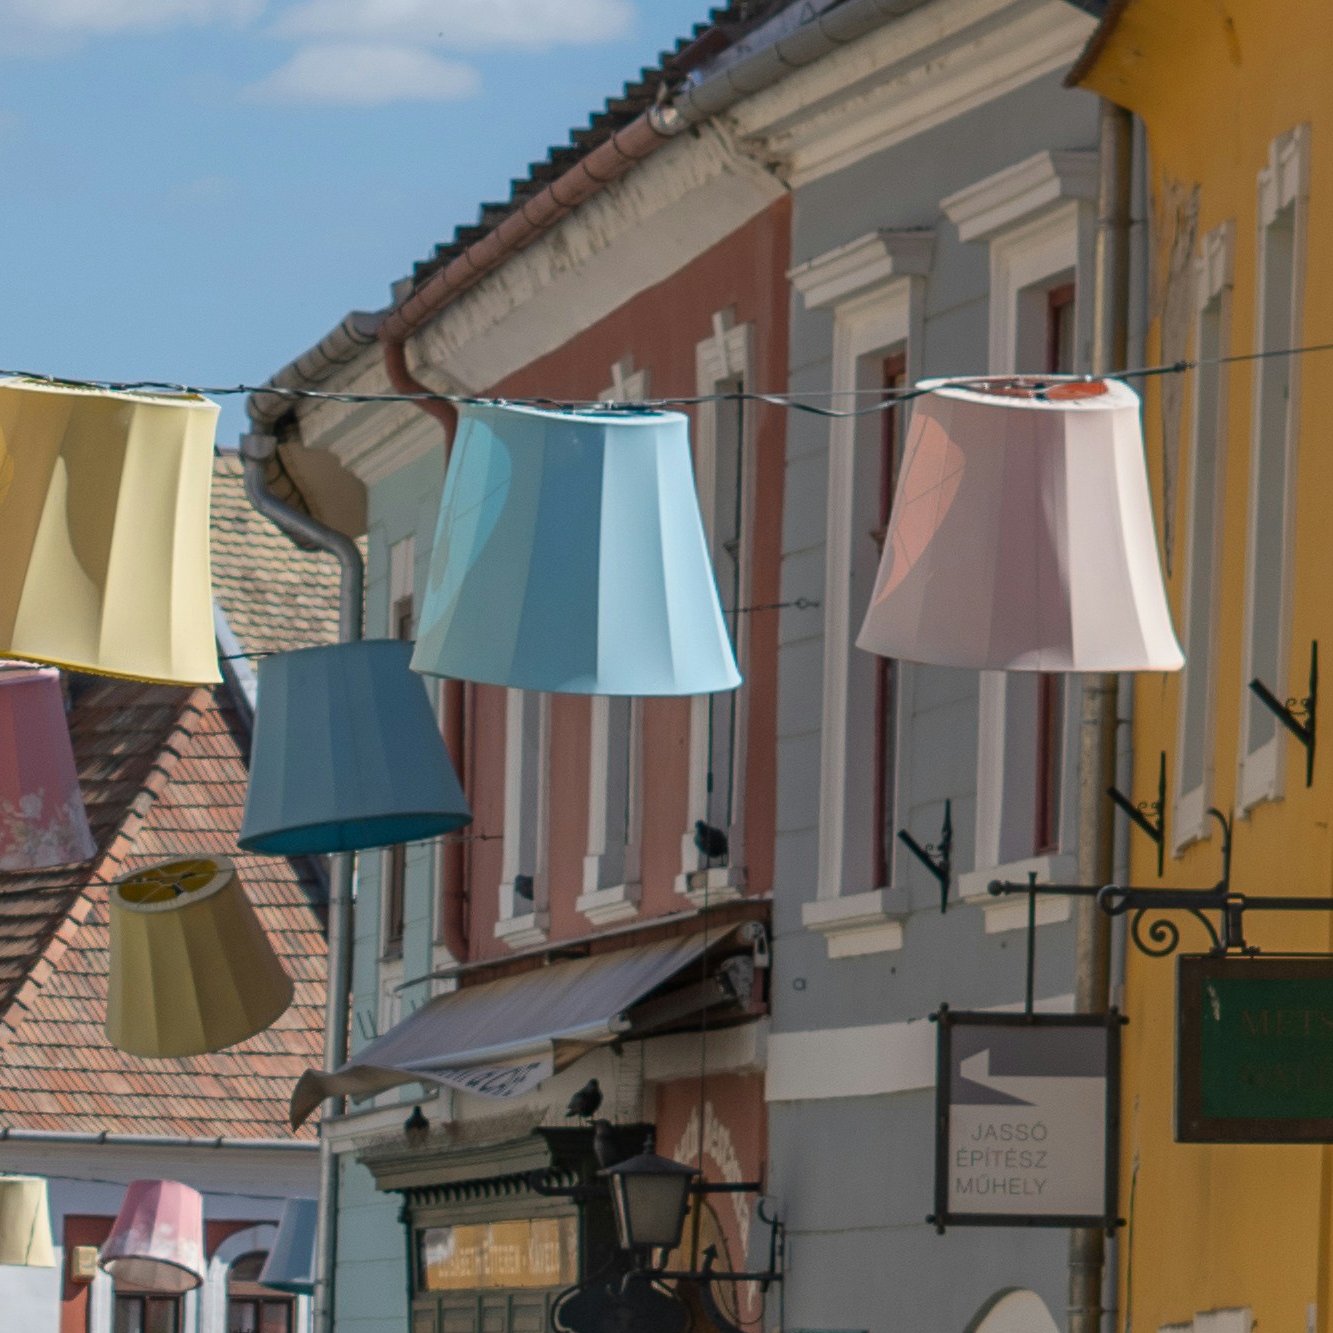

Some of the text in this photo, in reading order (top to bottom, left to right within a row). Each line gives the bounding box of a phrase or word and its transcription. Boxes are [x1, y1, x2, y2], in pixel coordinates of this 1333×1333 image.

[971, 1121, 1048, 1142] JASSÓ
[956, 1147, 1048, 1169] ÉPÍTÉSZ
[955, 1174, 1047, 1196] MŰHELY
